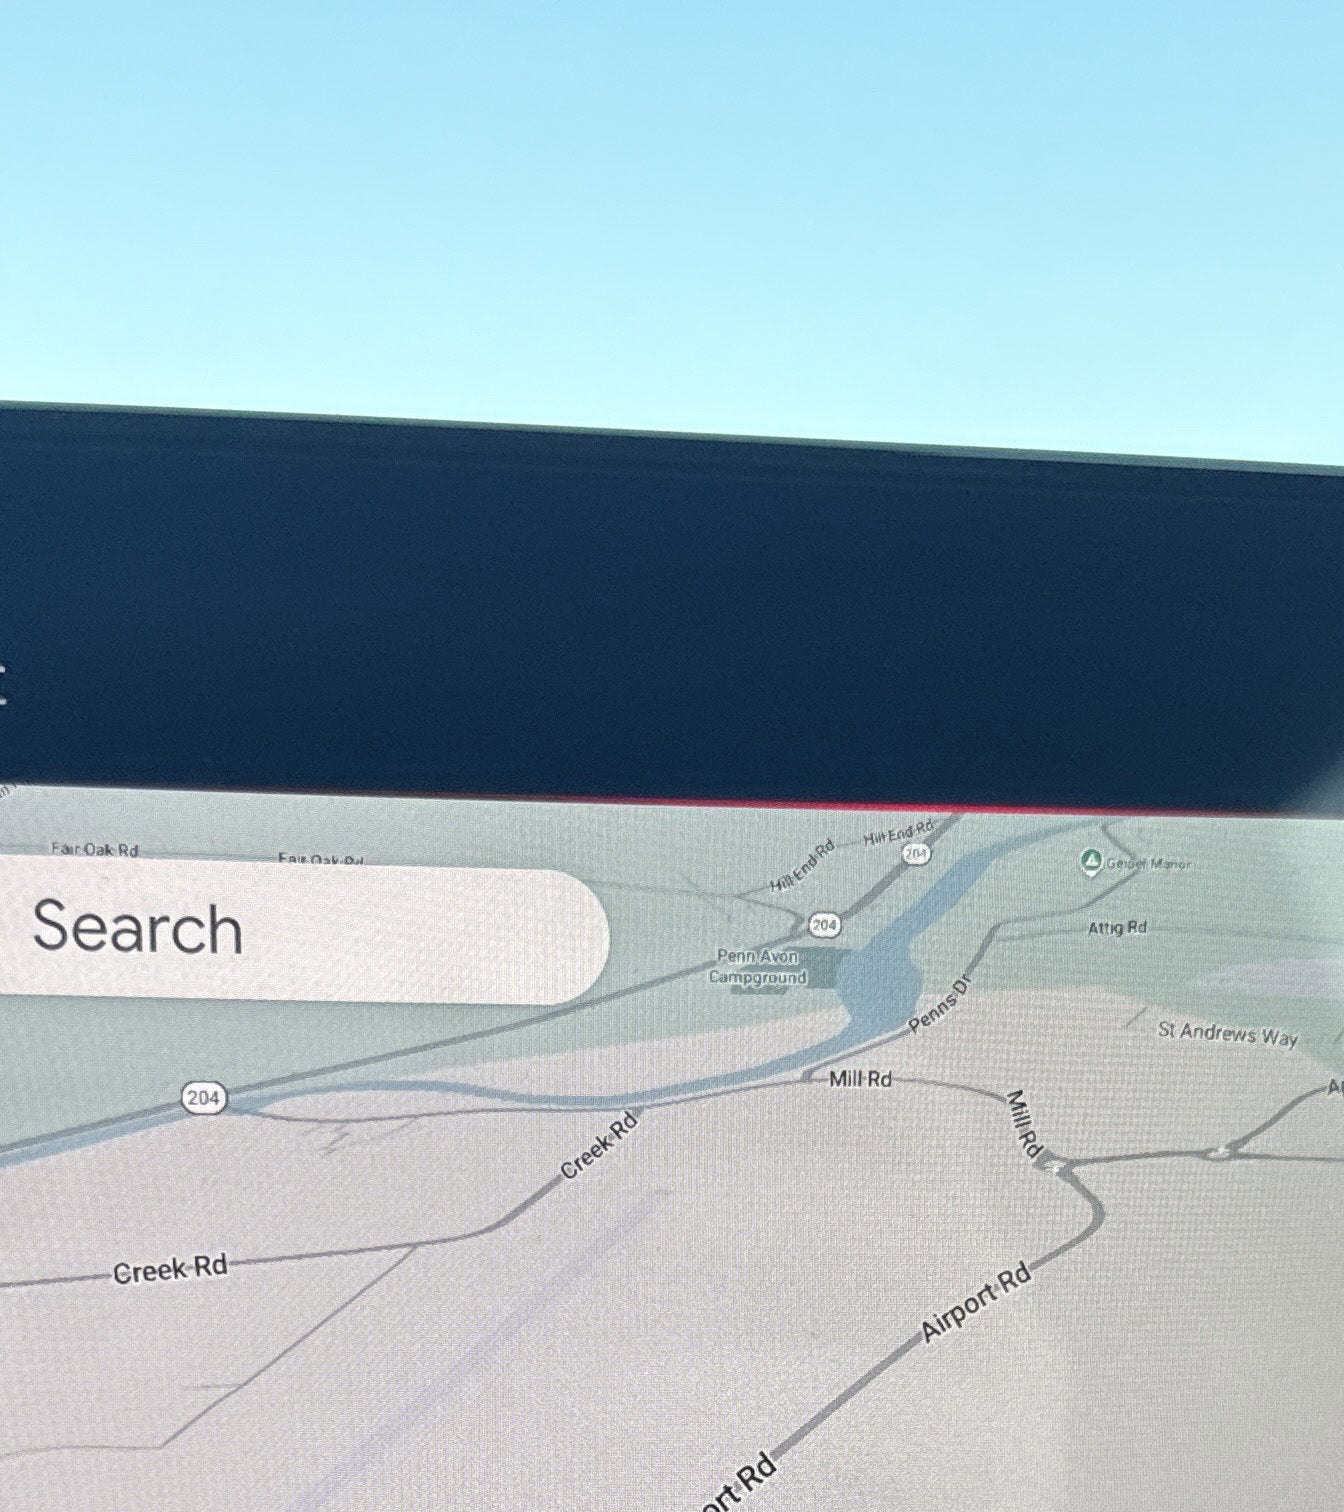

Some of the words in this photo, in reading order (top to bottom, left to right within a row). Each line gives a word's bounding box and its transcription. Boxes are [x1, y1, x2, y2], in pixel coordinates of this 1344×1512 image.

[888, 826, 914, 841] End
[916, 819, 934, 835] Rd
[84, 842, 114, 856] Oak
[119, 843, 139, 858] Rd
[793, 855, 817, 881] End
[815, 837, 836, 859] Rd
[34, 898, 242, 955] Search
[812, 919, 837, 931] 204
[1127, 920, 1148, 935] Rd
[717, 949, 756, 963] Penn
[760, 950, 798, 964] Avon
[709, 970, 807, 989] Campground
[908, 994, 957, 1034] Penns
[953, 973, 972, 996] Dr
[1158, 1020, 1175, 1038] St
[1179, 1022, 1257, 1046] Andrews
[1262, 1028, 1299, 1049] Way
[829, 1069, 863, 1087] Mill
[868, 1070, 893, 1088] Rd
[187, 1090, 220, 1106] 204
[1006, 1089, 1032, 1129] Mill
[560, 1135, 615, 1180] Creek
[609, 1110, 639, 1140] Rd
[1018, 1129, 1044, 1159] Rd
[113, 1256, 188, 1285] Creek
[194, 1252, 228, 1277] Rd
[921, 1282, 998, 1344] Airport
[997, 1260, 1032, 1293] Rd
[735, 1450, 777, 1492] Rd
